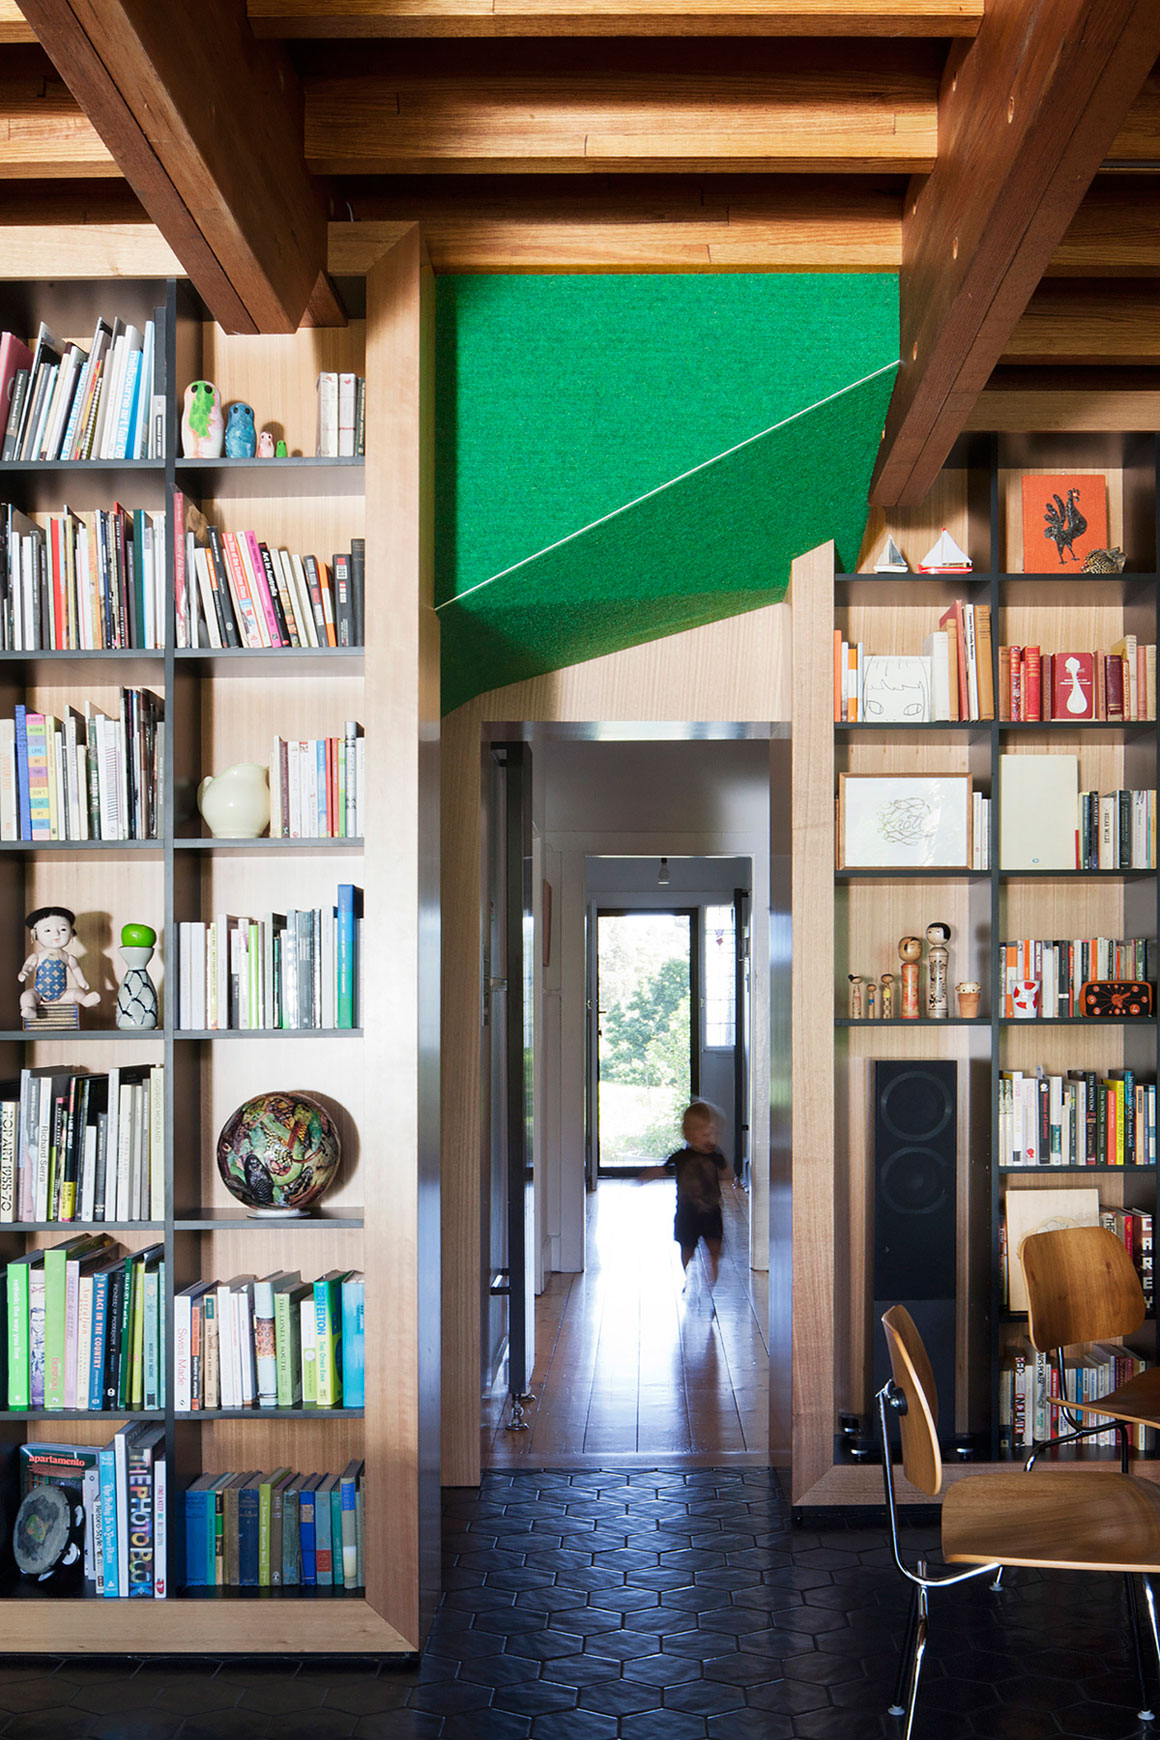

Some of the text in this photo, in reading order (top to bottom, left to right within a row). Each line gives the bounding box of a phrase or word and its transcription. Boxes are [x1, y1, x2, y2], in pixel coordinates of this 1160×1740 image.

[120, 352, 138, 408] melbourne
[116, 427, 129, 444] fair
[119, 410, 130, 425] art
[261, 551, 269, 562] Art
[266, 569, 278, 597] Australia
[1, 1111, 13, 1211] POP ART 1955-70
[39, 1125, 48, 1182] Richard Serra
[1142, 1218, 1152, 1309] CAREY
[82, 1288, 90, 1335] Australian
[95, 1312, 103, 1320] IN
[96, 1289, 104, 1311] PLACE
[316, 1286, 327, 1335] BEN ELTON
[95, 1322, 103, 1335] THE
[93, 1336, 102, 1369] COUNTRY
[178, 1328, 187, 1386] Swiss Made
[29, 1455, 85, 1466] apartamento
